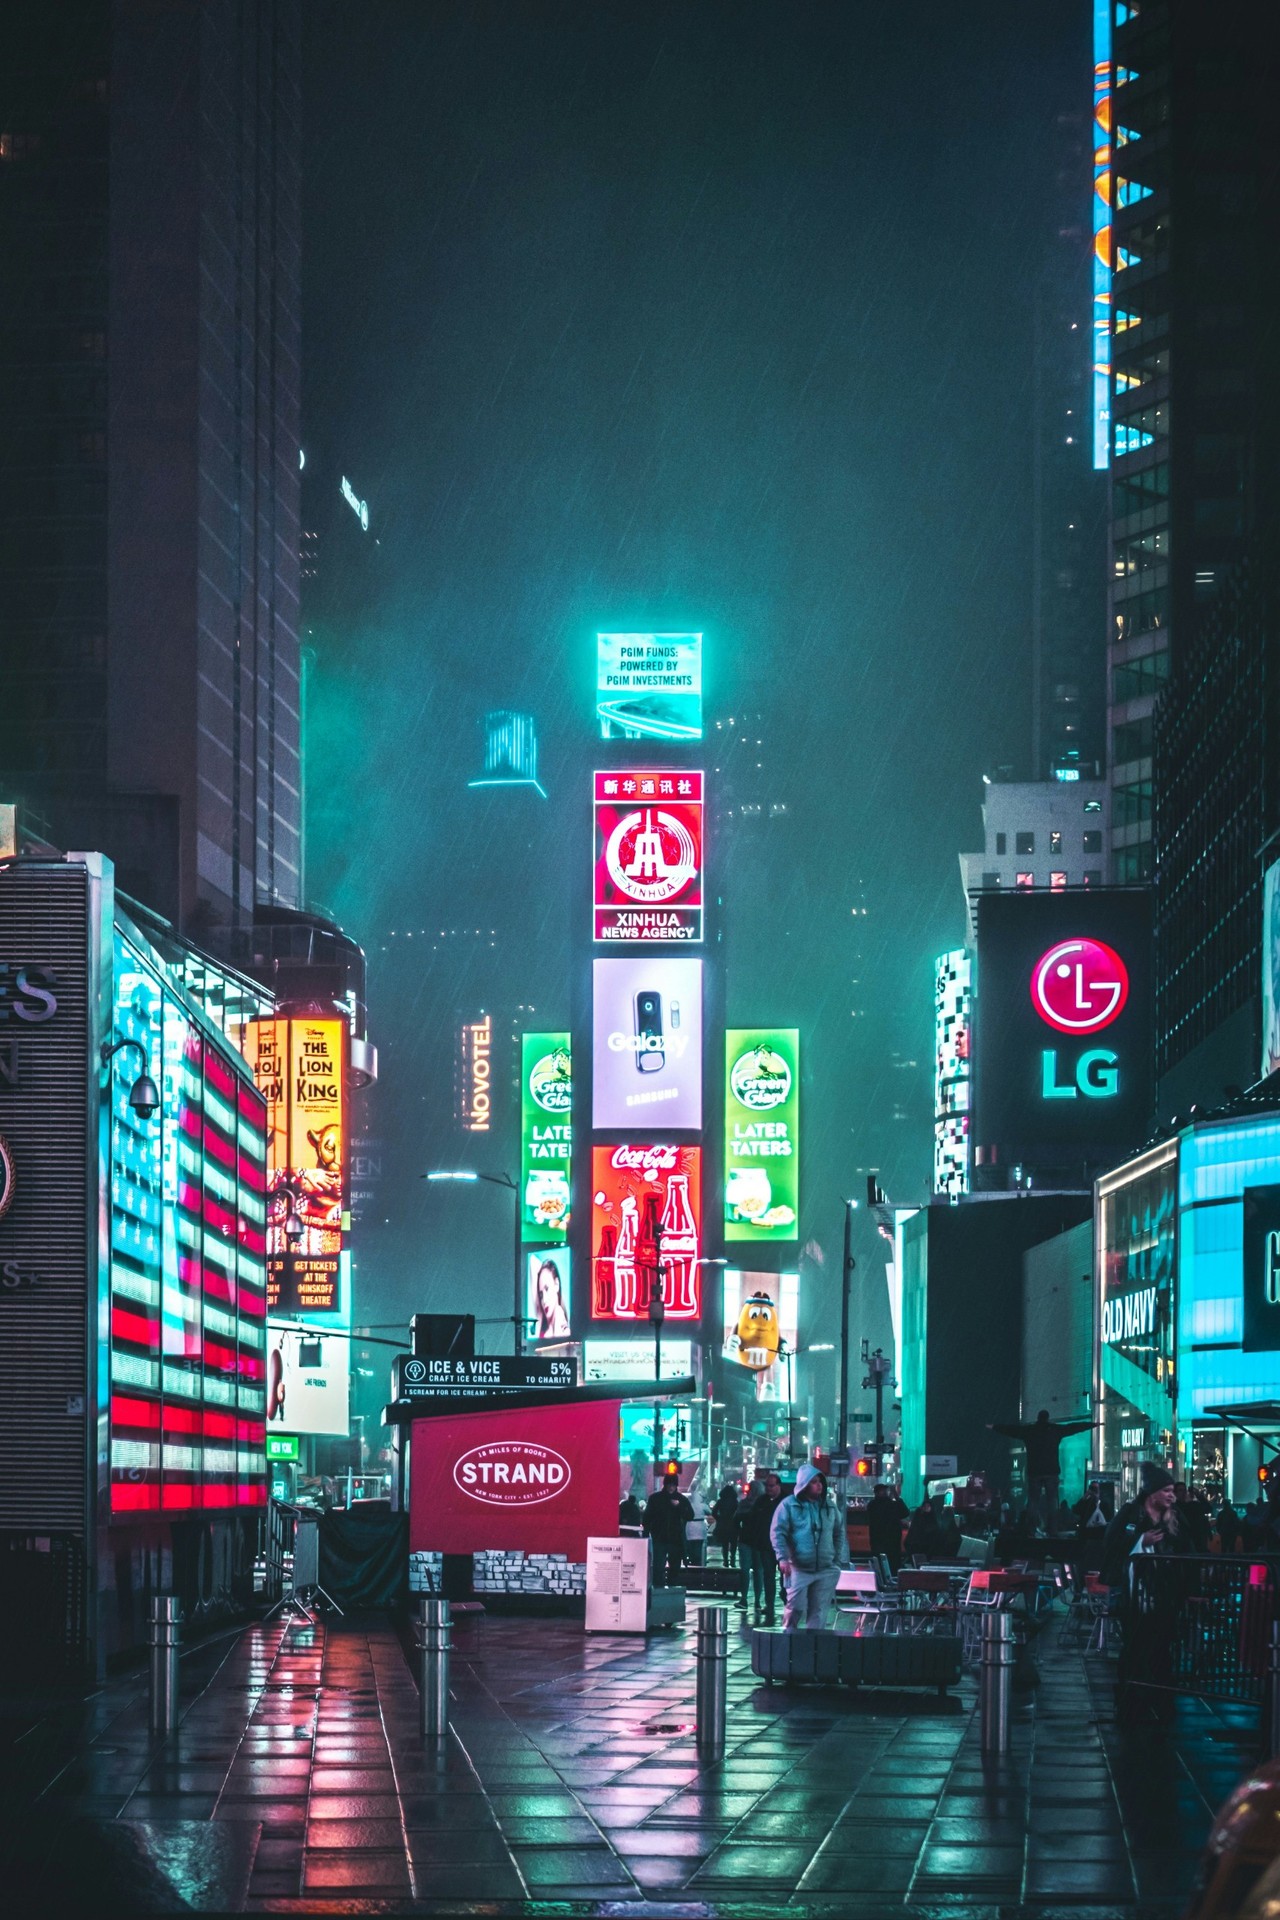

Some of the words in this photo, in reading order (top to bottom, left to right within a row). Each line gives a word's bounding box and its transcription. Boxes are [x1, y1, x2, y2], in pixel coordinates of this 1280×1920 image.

[621, 647, 644, 657] PGIM
[646, 647, 678, 657] FUNDS:
[620, 661, 663, 671] POWERED
[666, 661, 678, 671] BY
[607, 675, 630, 685] PGIM
[633, 675, 692, 685] INVESTMENTS
[604, 779, 692, 794] 新华通讯社
[625, 883, 675, 898] XINHUA
[617, 913, 680, 926] XINHUA
[602, 927, 639, 938] NEWS
[641, 927, 694, 938] AGENCY
[303, 1042, 327, 1053] THE
[607, 1031, 689, 1058] Galaxy
[299, 1056, 333, 1076] LION
[471, 1016, 490, 1130] NOVOTEL
[1042, 1050, 1119, 1098] LG
[297, 1079, 338, 1102] KING
[734, 1123, 787, 1138] LATER
[730, 1141, 792, 1156] TATERS
[294, 1261, 308, 1271] GET
[309, 1261, 338, 1271] TICKETS
[304, 1272, 313, 1282] AT
[314, 1272, 328, 1282] THE
[297, 1284, 333, 1294] MINSKOFF
[301, 1295, 331, 1305] THEATRE
[1103, 1298, 1123, 1344] OLD
[1124, 1287, 1156, 1339] NAVY
[429, 1361, 450, 1373] ICE
[455, 1361, 466, 1373] &
[470, 1361, 500, 1374] VICE
[551, 1363, 571, 1375] 5%
[457, 1375, 470, 1383] ICE
[472, 1375, 500, 1383] CREAM
[538, 1376, 571, 1384] CHARITY
[1121, 1428, 1131, 1448] OLD
[1131, 1428, 1145, 1447] NAVY
[489, 1447, 510, 1455] MILES
[524, 1447, 547, 1458] BOOKS
[462, 1462, 564, 1484] STRAND
[475, 1488, 487, 1496] NEW
